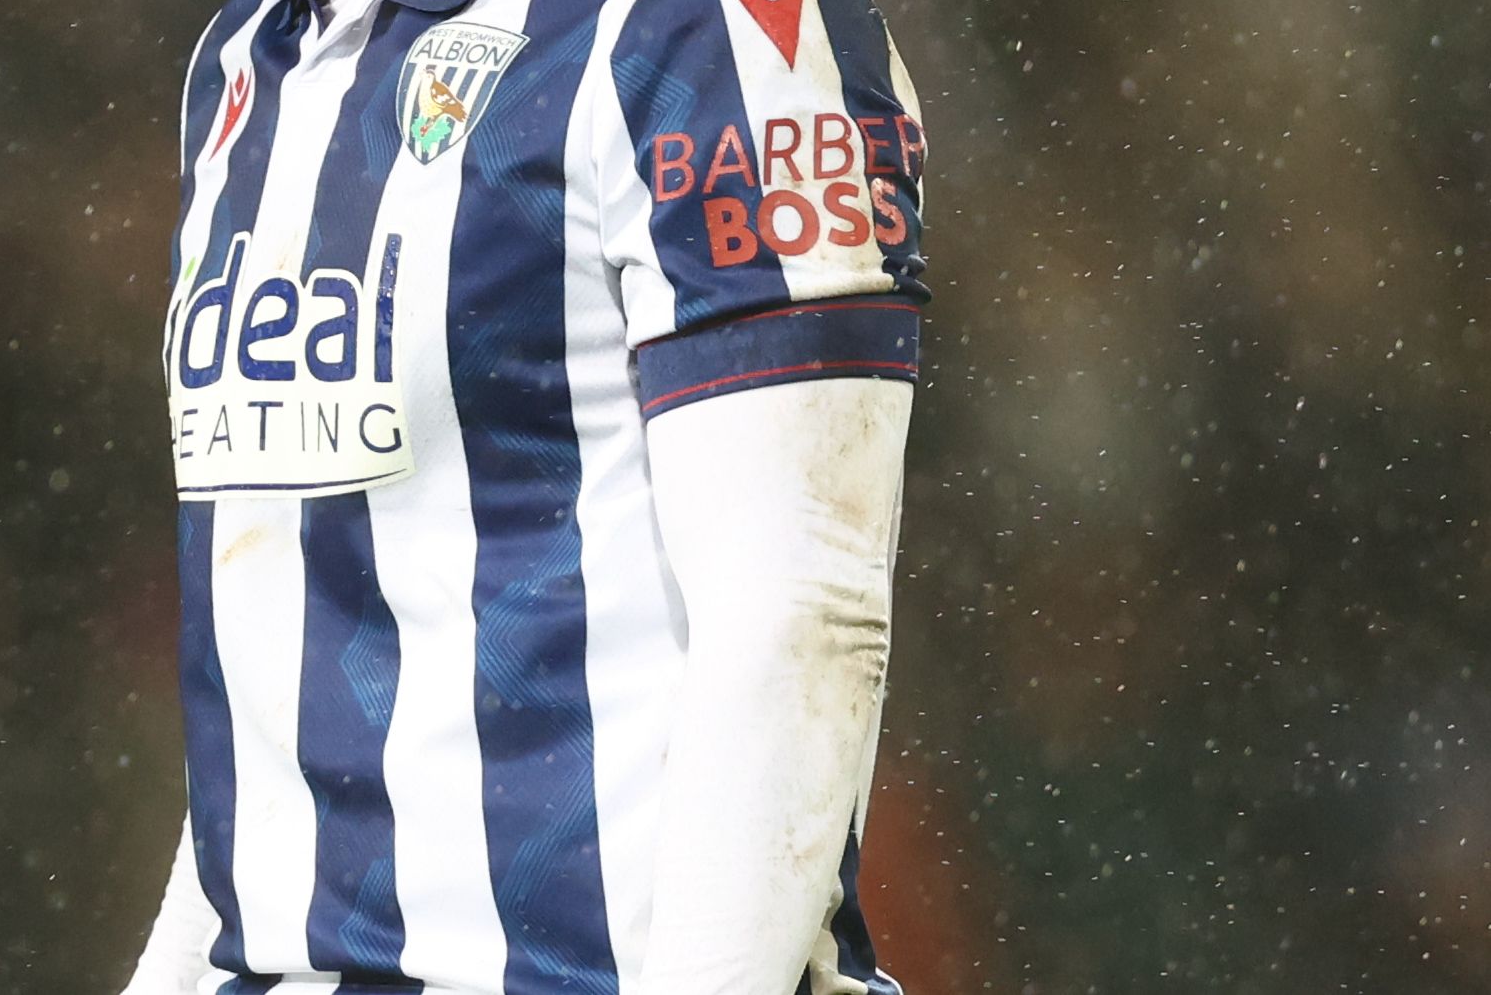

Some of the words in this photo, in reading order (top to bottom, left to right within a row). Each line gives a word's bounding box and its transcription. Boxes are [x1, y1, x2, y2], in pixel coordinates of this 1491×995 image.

[415, 37, 509, 66] ALBION
[428, 28, 455, 37] WEST
[457, 30, 517, 47] BROMWICH
[652, 112, 924, 202] BARBER
[703, 177, 907, 268] BOSS
